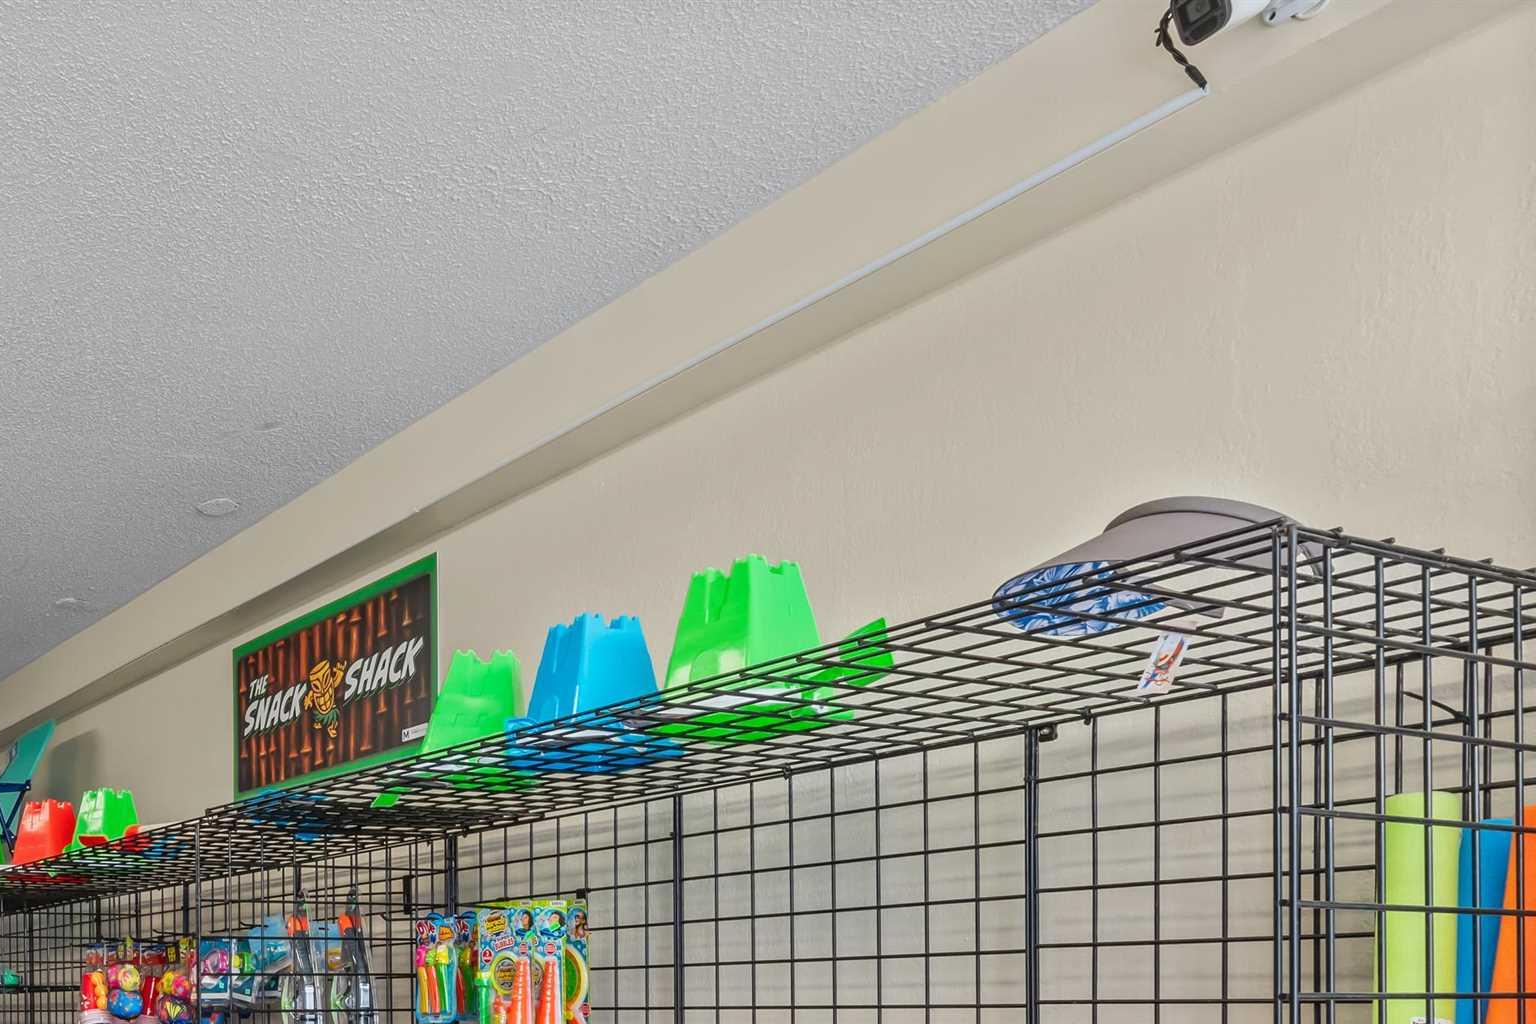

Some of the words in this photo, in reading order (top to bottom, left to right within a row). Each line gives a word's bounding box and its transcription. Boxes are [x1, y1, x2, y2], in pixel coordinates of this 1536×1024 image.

[243, 683, 308, 736] SNACK
[344, 636, 424, 701] SHACK
[249, 674, 269, 700] THE
